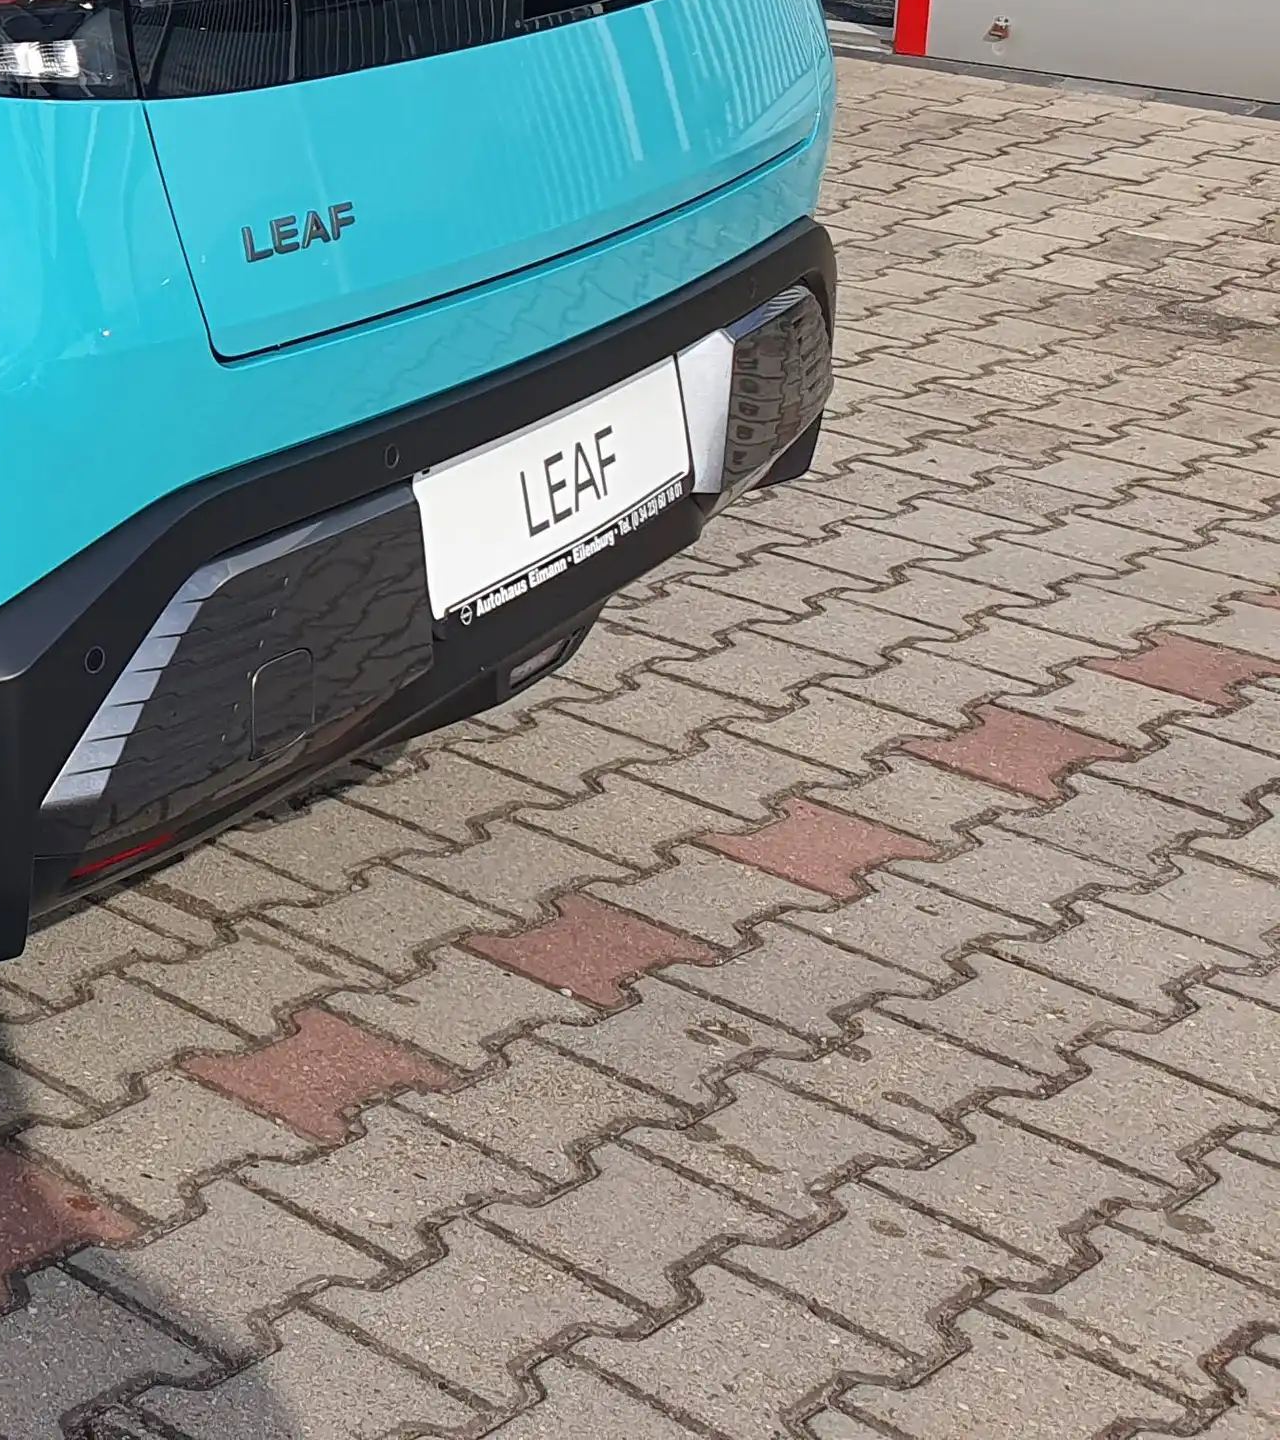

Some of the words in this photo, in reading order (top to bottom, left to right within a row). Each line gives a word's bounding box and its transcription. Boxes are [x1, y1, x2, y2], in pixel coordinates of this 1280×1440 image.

[241, 201, 355, 263] LEAF
[520, 425, 616, 538] LEAF
[476, 579, 528, 617] Autohaus
[527, 557, 568, 589] Eimann
[572, 529, 615, 565] Eilenburg
[618, 516, 632, 536] Tel.
